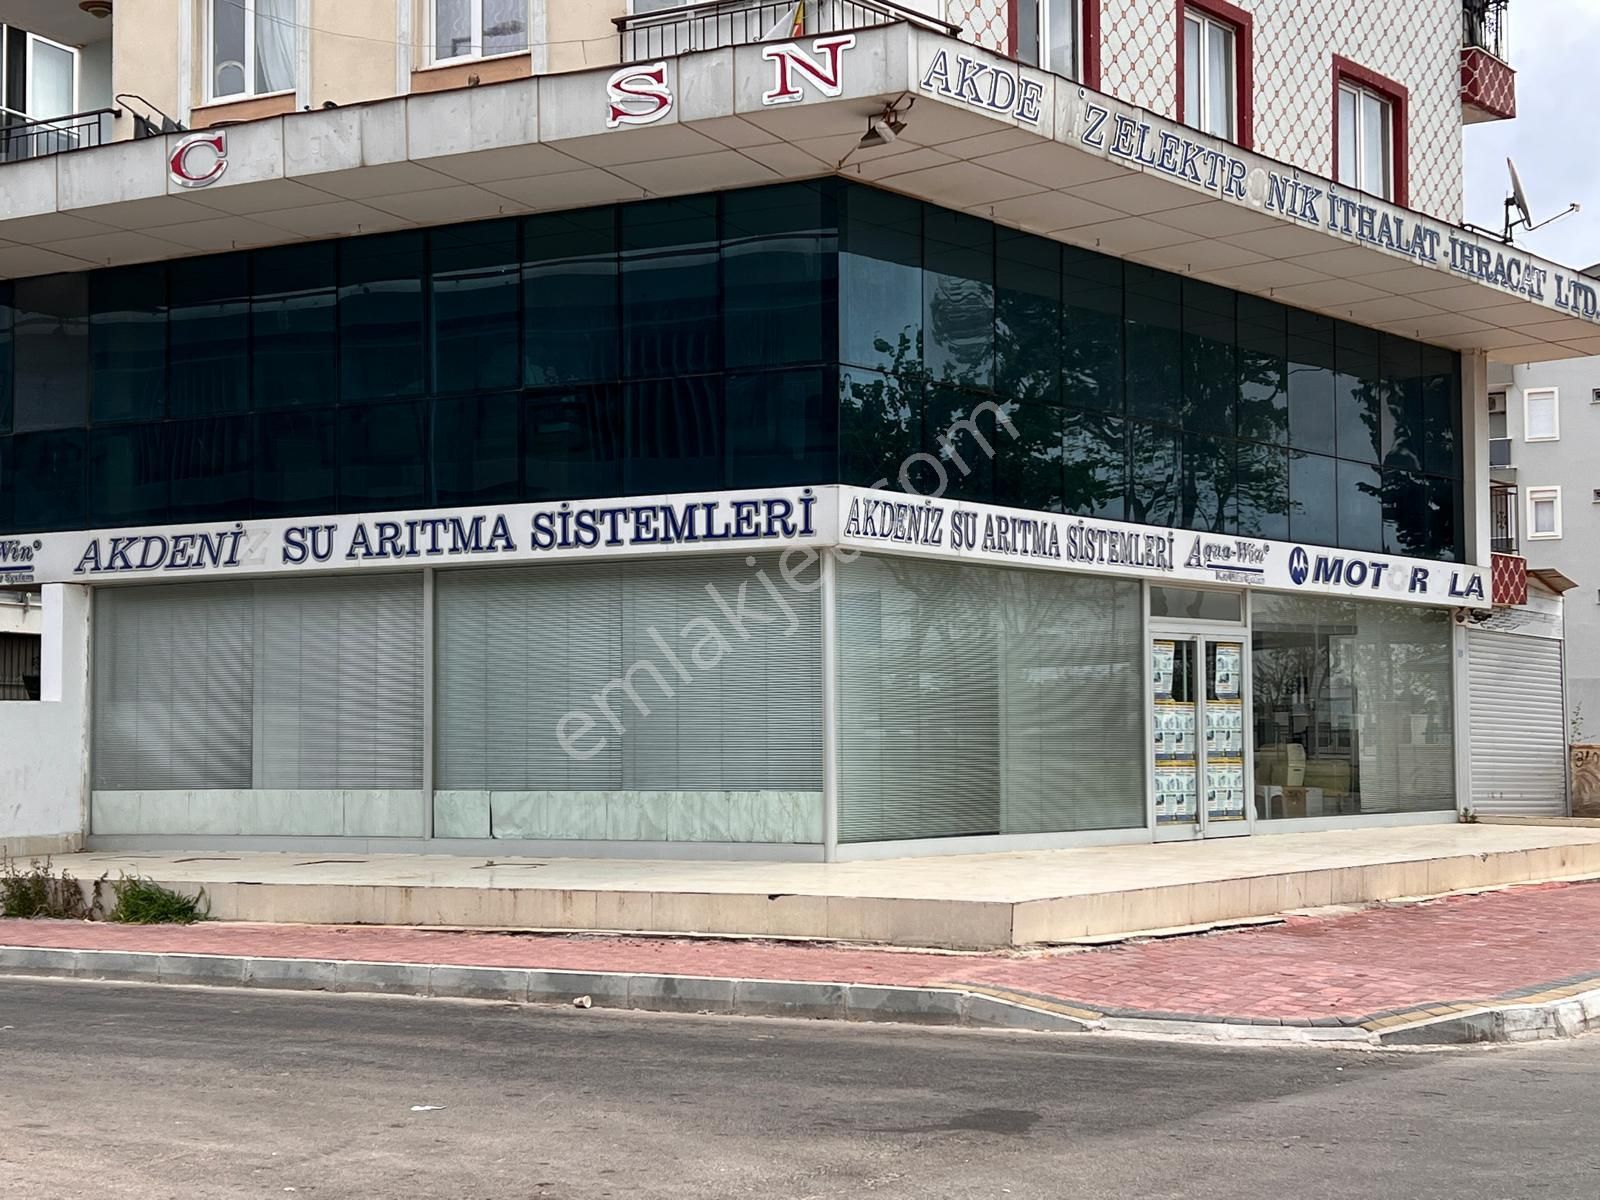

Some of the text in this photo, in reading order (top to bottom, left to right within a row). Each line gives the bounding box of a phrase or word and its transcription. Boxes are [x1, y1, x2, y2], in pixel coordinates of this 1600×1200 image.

[282, 524, 337, 565] SU
[345, 513, 517, 561] ARITMA
[530, 487, 817, 551] SİSTEMLERİ
[844, 495, 1175, 571] AKDENİZ SU ARITMA SİSTEMLERİ
